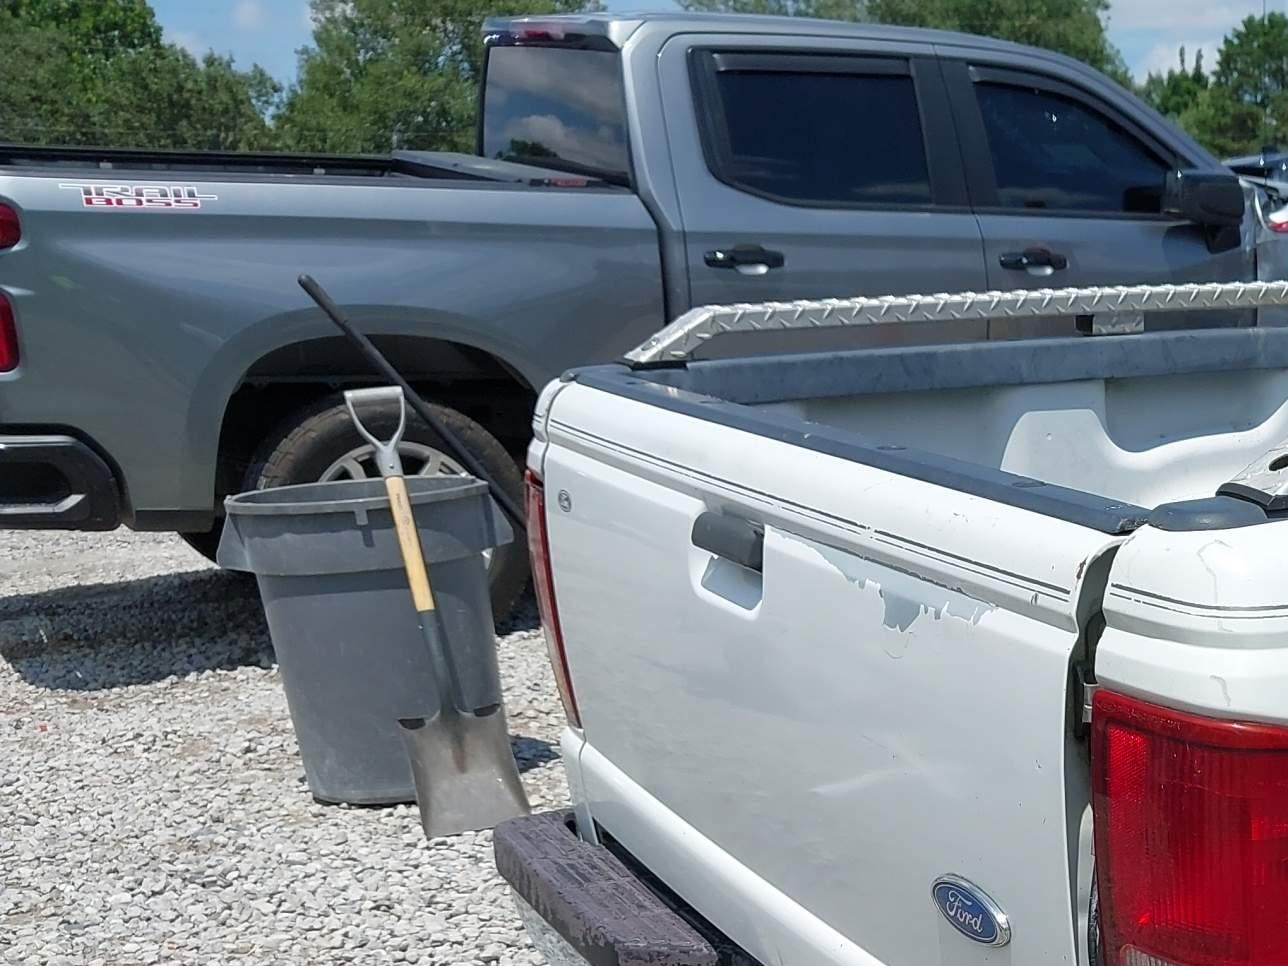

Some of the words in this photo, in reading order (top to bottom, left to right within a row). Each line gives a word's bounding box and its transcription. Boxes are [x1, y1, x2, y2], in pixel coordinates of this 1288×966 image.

[59, 183, 218, 201] TRAIL
[83, 196, 200, 209] BOSS
[946, 890, 985, 933] Ford
